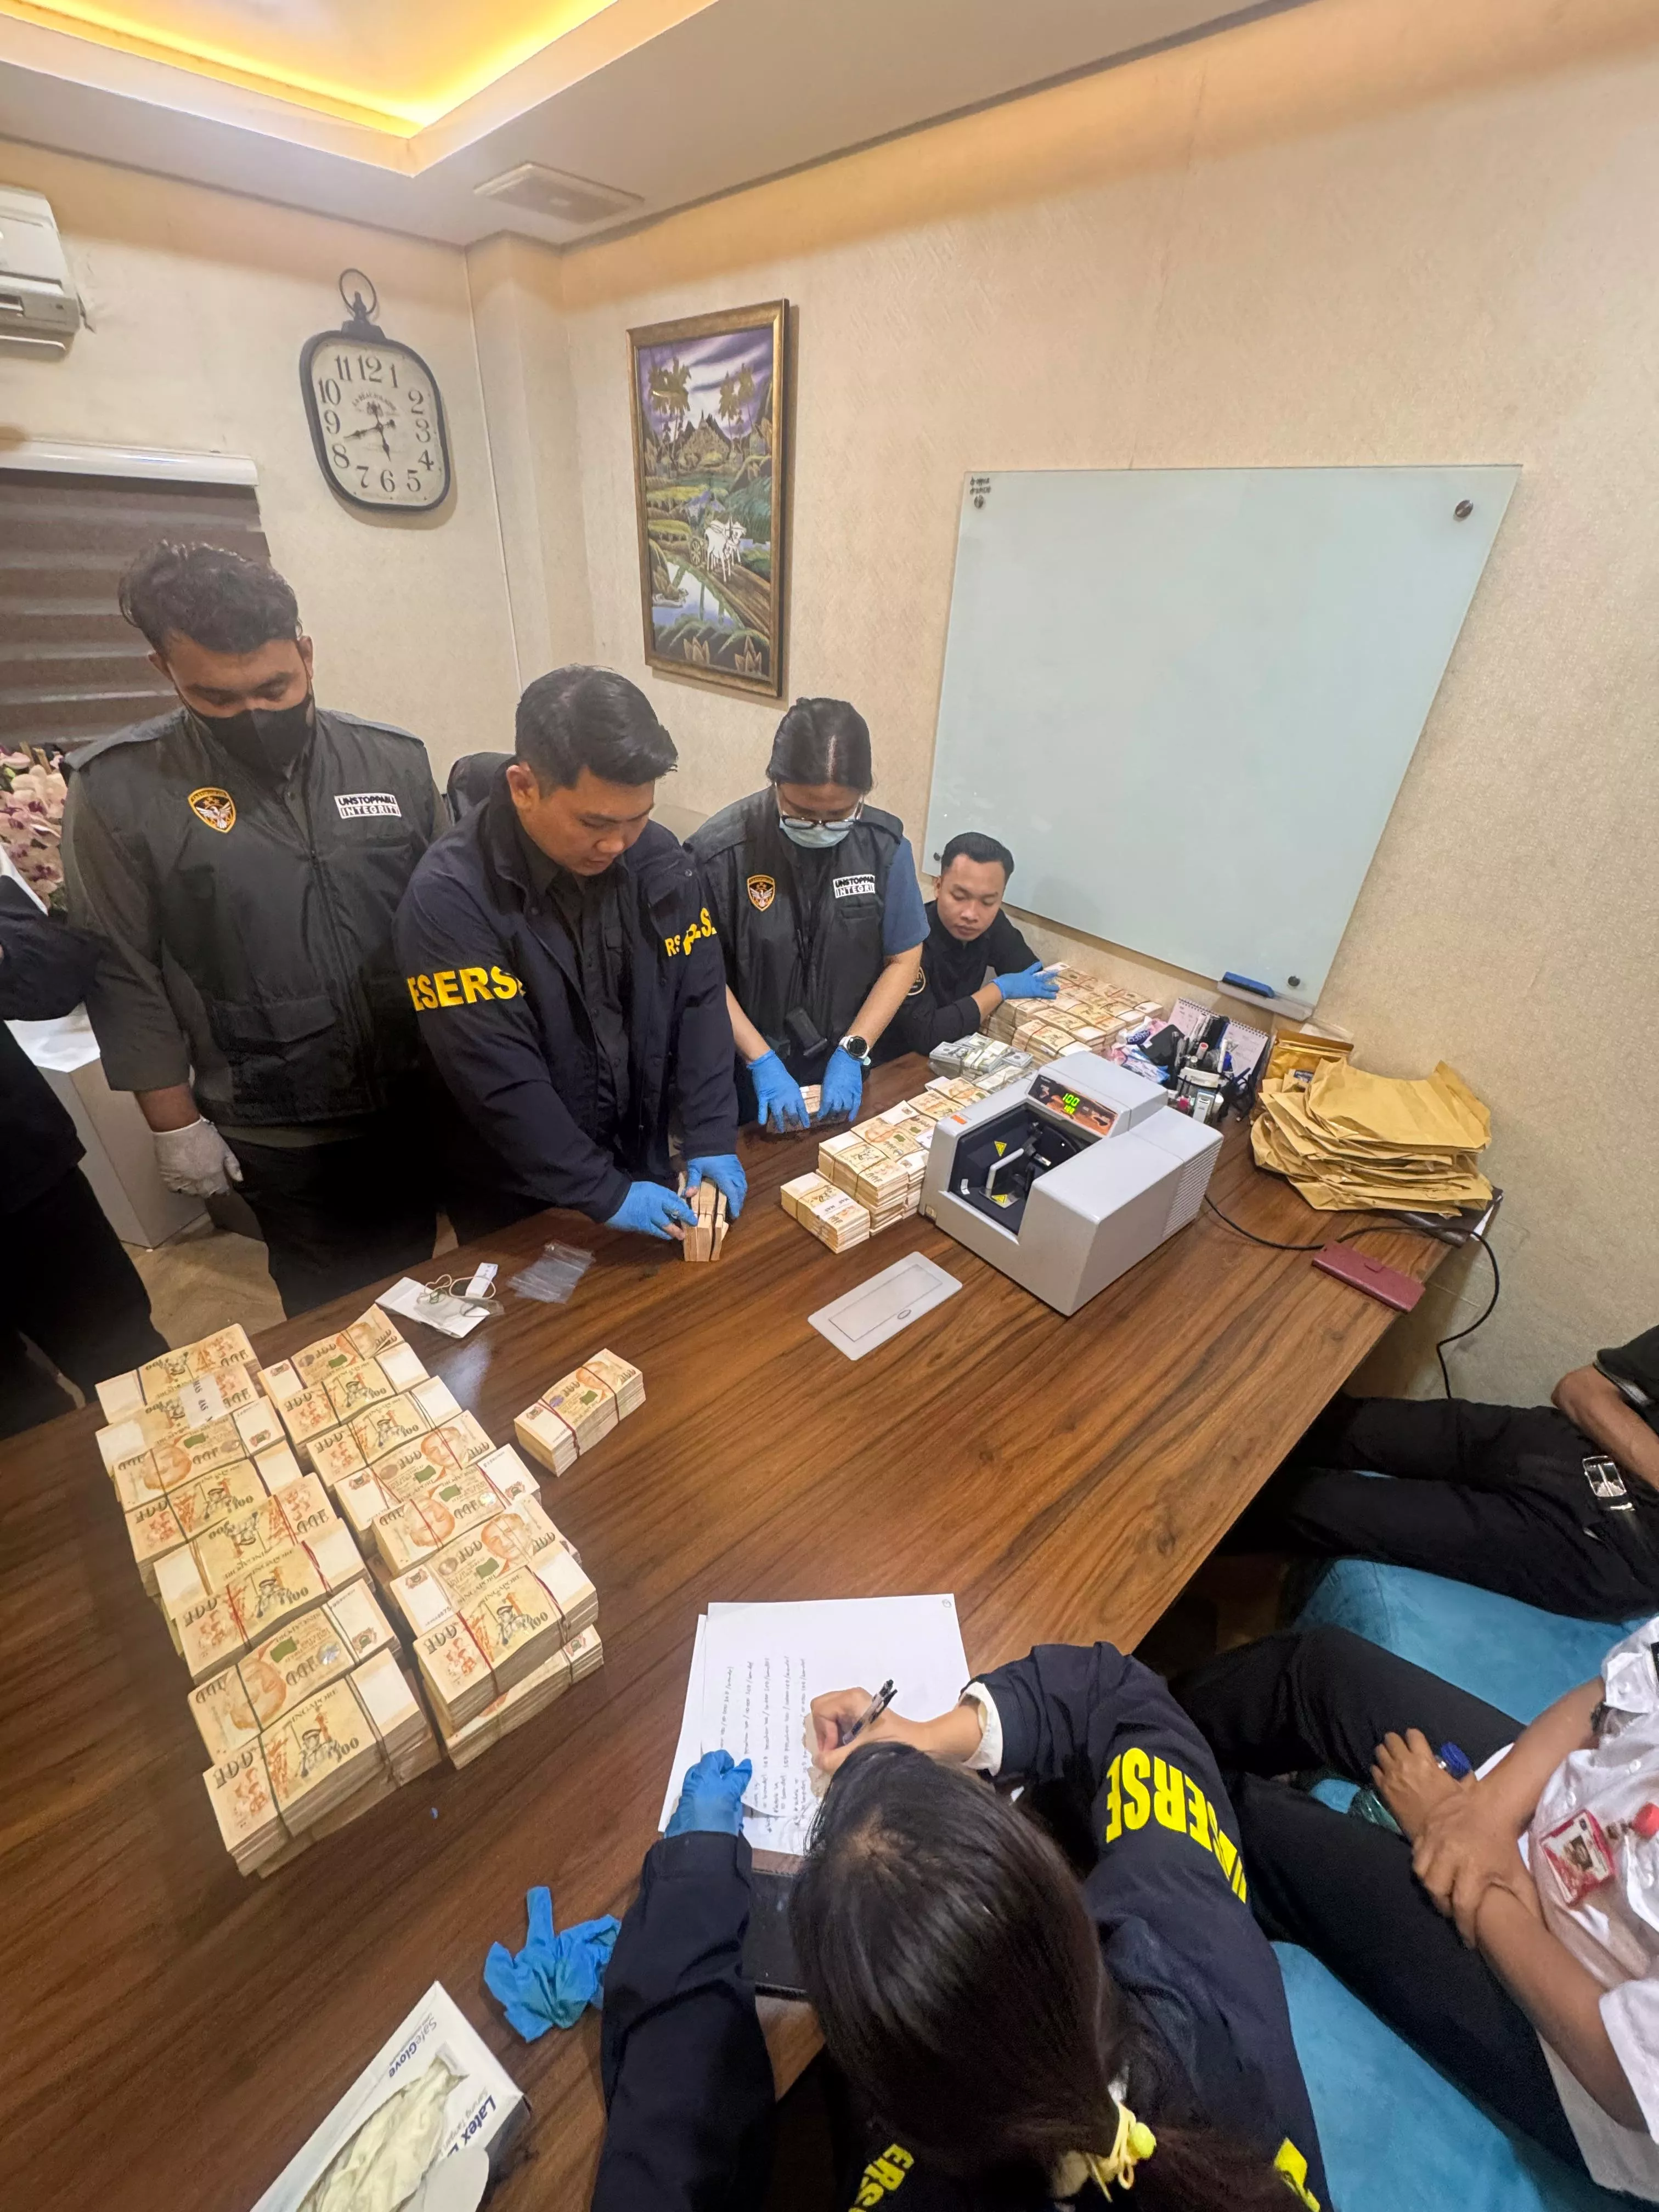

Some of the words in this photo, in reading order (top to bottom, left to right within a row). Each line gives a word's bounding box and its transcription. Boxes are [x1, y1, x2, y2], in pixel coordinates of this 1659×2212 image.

[334, 355, 352, 382] 11
[358, 355, 382, 383] 12
[389, 364, 398, 388] 1
[318, 378, 341, 406] 10
[408, 390, 424, 415] 2
[324, 409, 341, 435] 9
[416, 419, 431, 443] 3
[332, 443, 351, 469] 8
[418, 449, 434, 471] 4
[357, 465, 369, 488] 7
[381, 470, 396, 493] 6
[407, 470, 421, 492] 5
[1063, 1093, 1080, 1107] 100
[456, 1541, 482, 1564] 100
[529, 1612, 549, 1630] 100
[422, 1624, 457, 1655] 100
[212, 1751, 253, 1789] 100
[388, 2017, 437, 2078] SafeGlove
[461, 2094, 496, 2146] Latex
[848, 2143, 915, 2212] ERS
